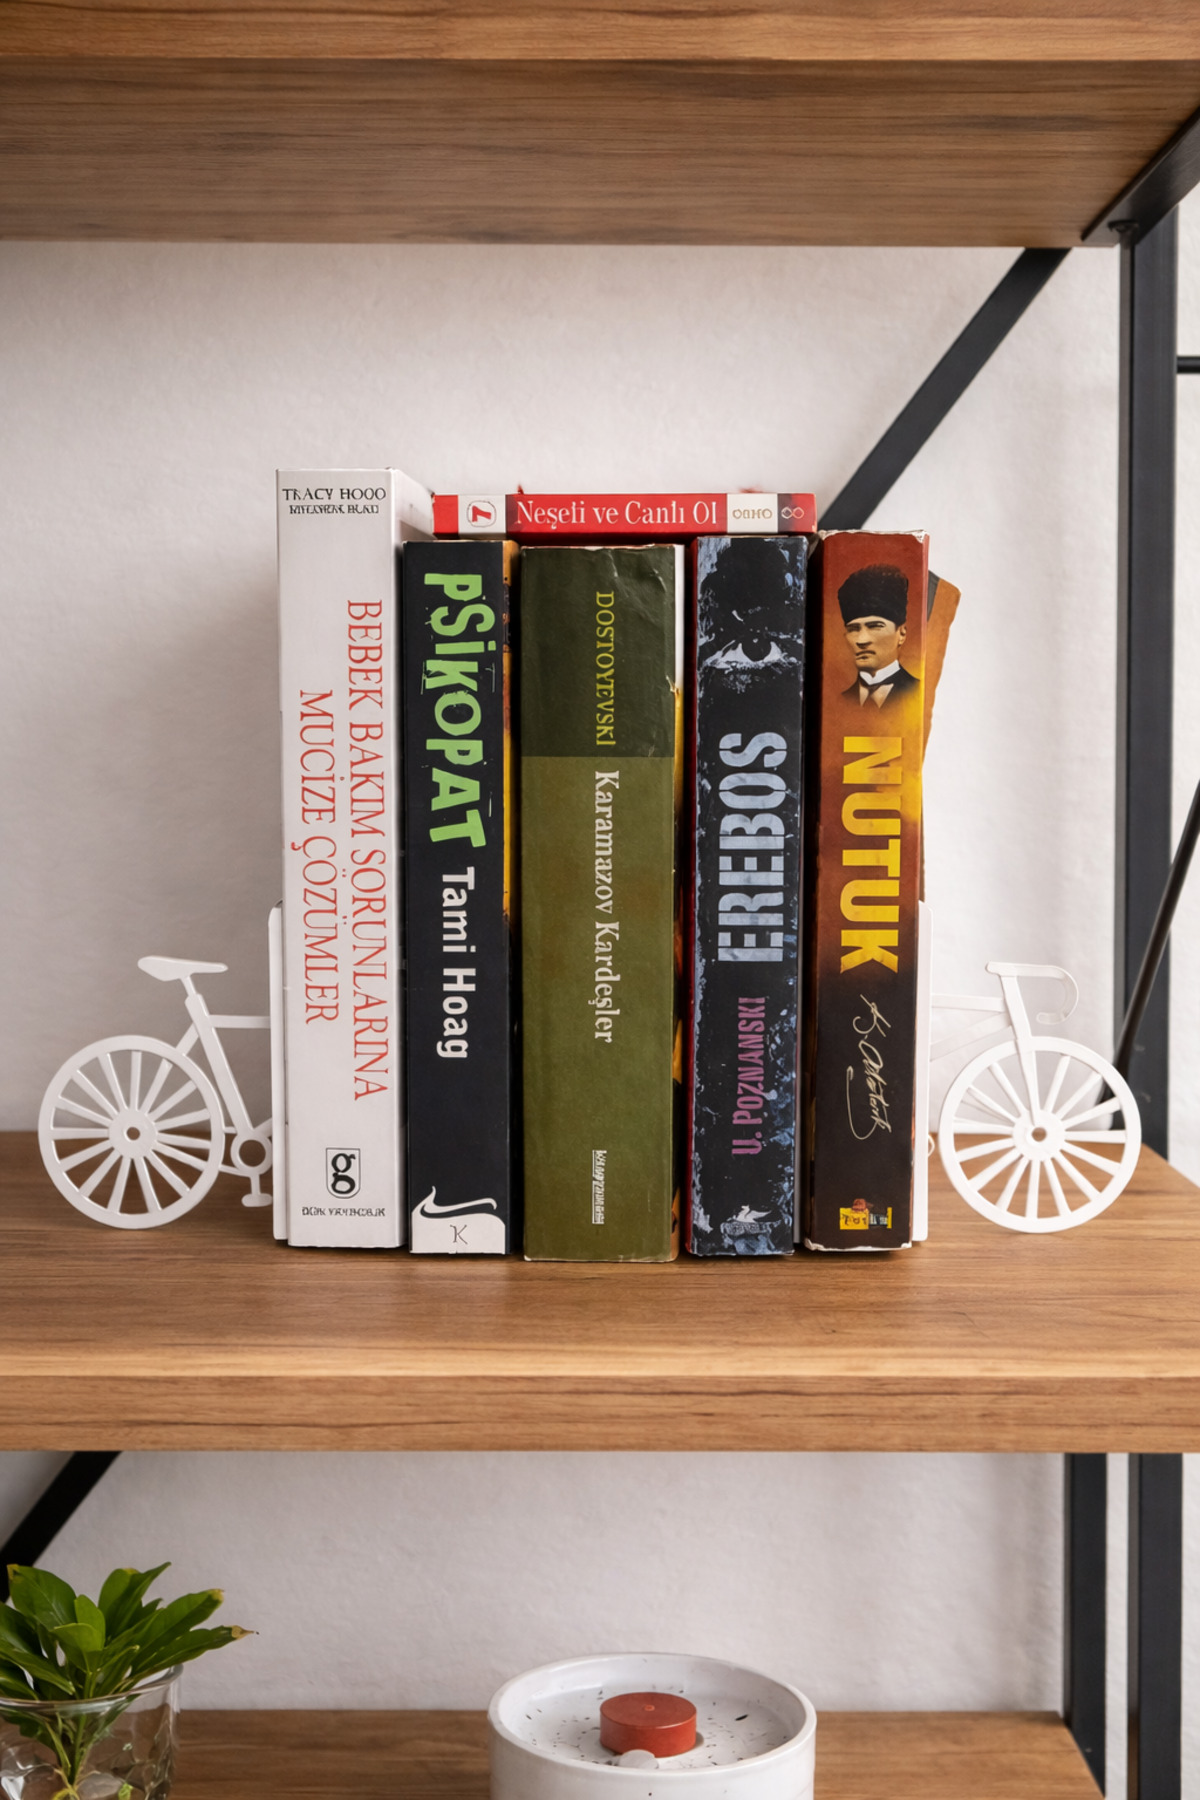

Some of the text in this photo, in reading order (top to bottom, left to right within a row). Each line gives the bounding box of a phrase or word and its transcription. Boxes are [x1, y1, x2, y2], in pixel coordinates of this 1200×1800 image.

[593, 507, 619, 524] ve
[624, 500, 685, 525] Canlı
[693, 500, 717, 525] Ol
[291, 689, 347, 1025] MUCİZE ÇÖZÜMLER
[347, 600, 389, 1101] BEBEK BAKIM SORUNLARINA
[442, 866, 477, 953] Tami
[588, 770, 621, 1044] Karamazov Kardeşler
[717, 732, 788, 963] EREBOS
[840, 735, 903, 974] NUTUK
[437, 967, 477, 1059] Hoag
[731, 997, 766, 1155] U. POZNANSKI
